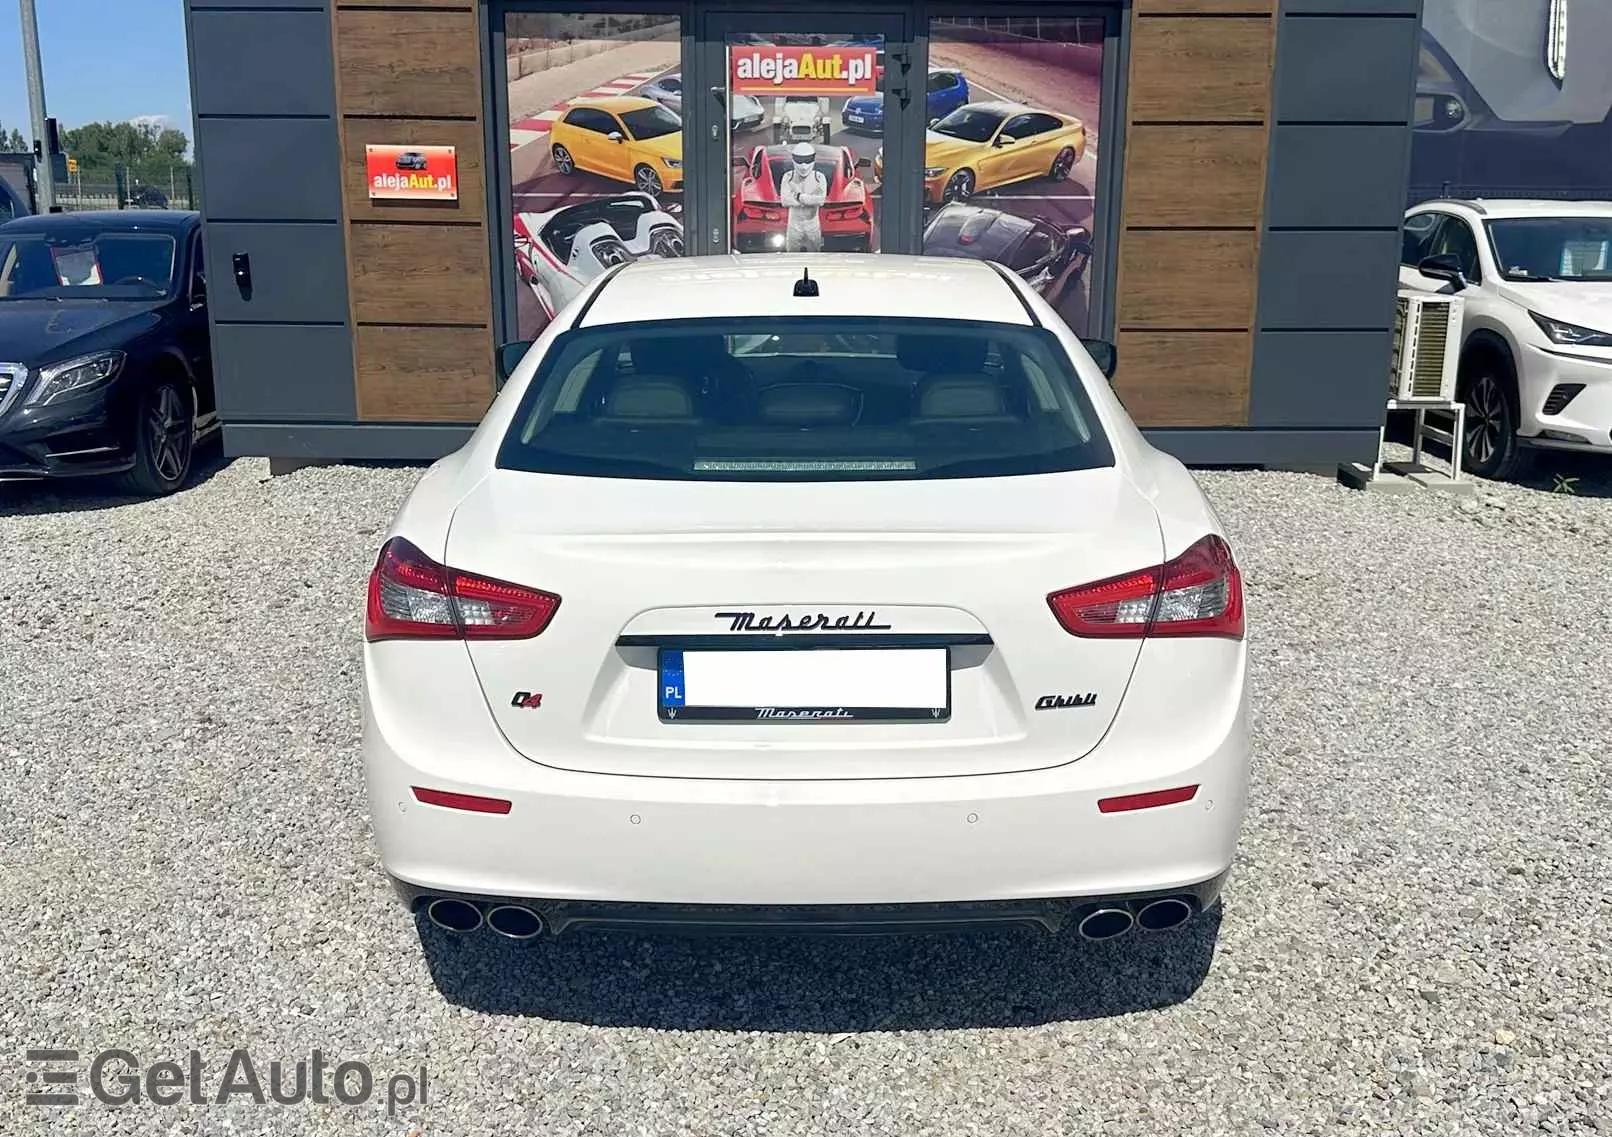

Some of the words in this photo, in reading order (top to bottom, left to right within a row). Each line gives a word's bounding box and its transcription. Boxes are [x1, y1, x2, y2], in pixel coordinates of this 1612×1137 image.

[737, 53, 872, 85] alejaAut.pl
[373, 172, 452, 191] alejaAut.pl
[714, 611, 892, 631] Maserati
[511, 691, 543, 709] Q4
[665, 686, 682, 699] PL
[755, 707, 854, 719] Maserati
